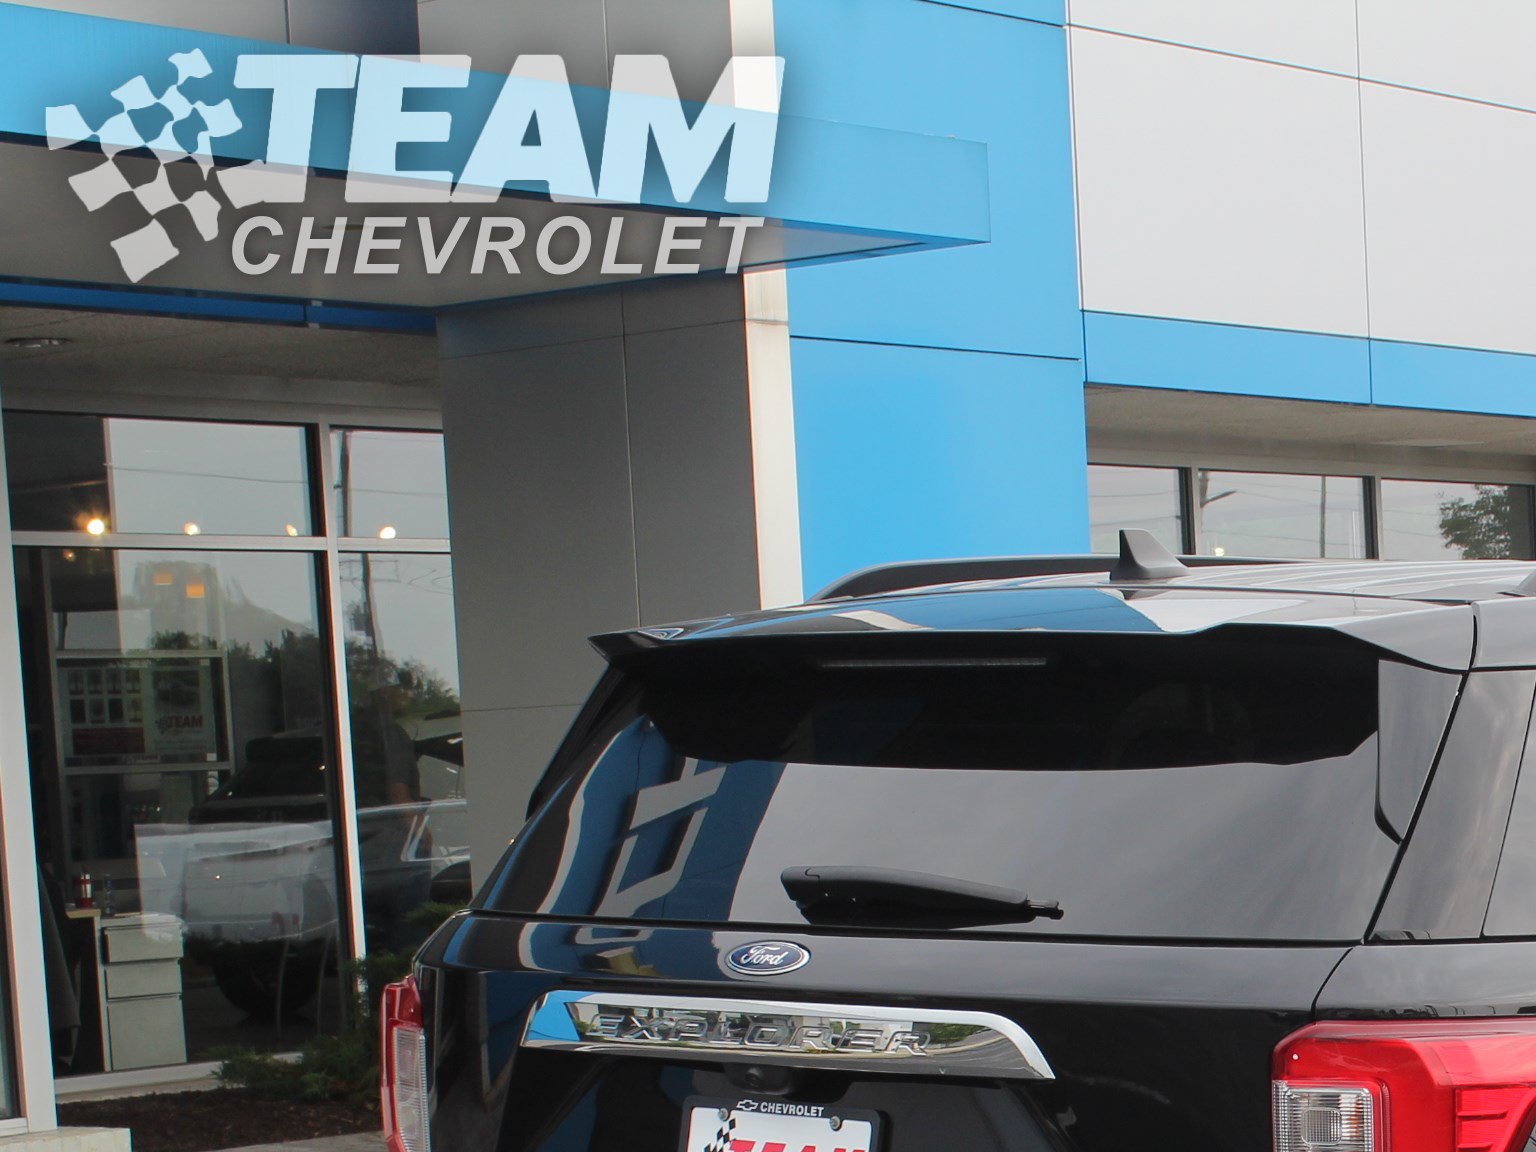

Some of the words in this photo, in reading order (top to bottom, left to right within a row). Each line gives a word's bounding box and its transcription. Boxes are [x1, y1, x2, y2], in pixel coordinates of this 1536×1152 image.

[740, 945, 789, 966] Ford
[584, 1012, 932, 1057] EXPLORER
[760, 1101, 825, 1118] CHEVROLET
